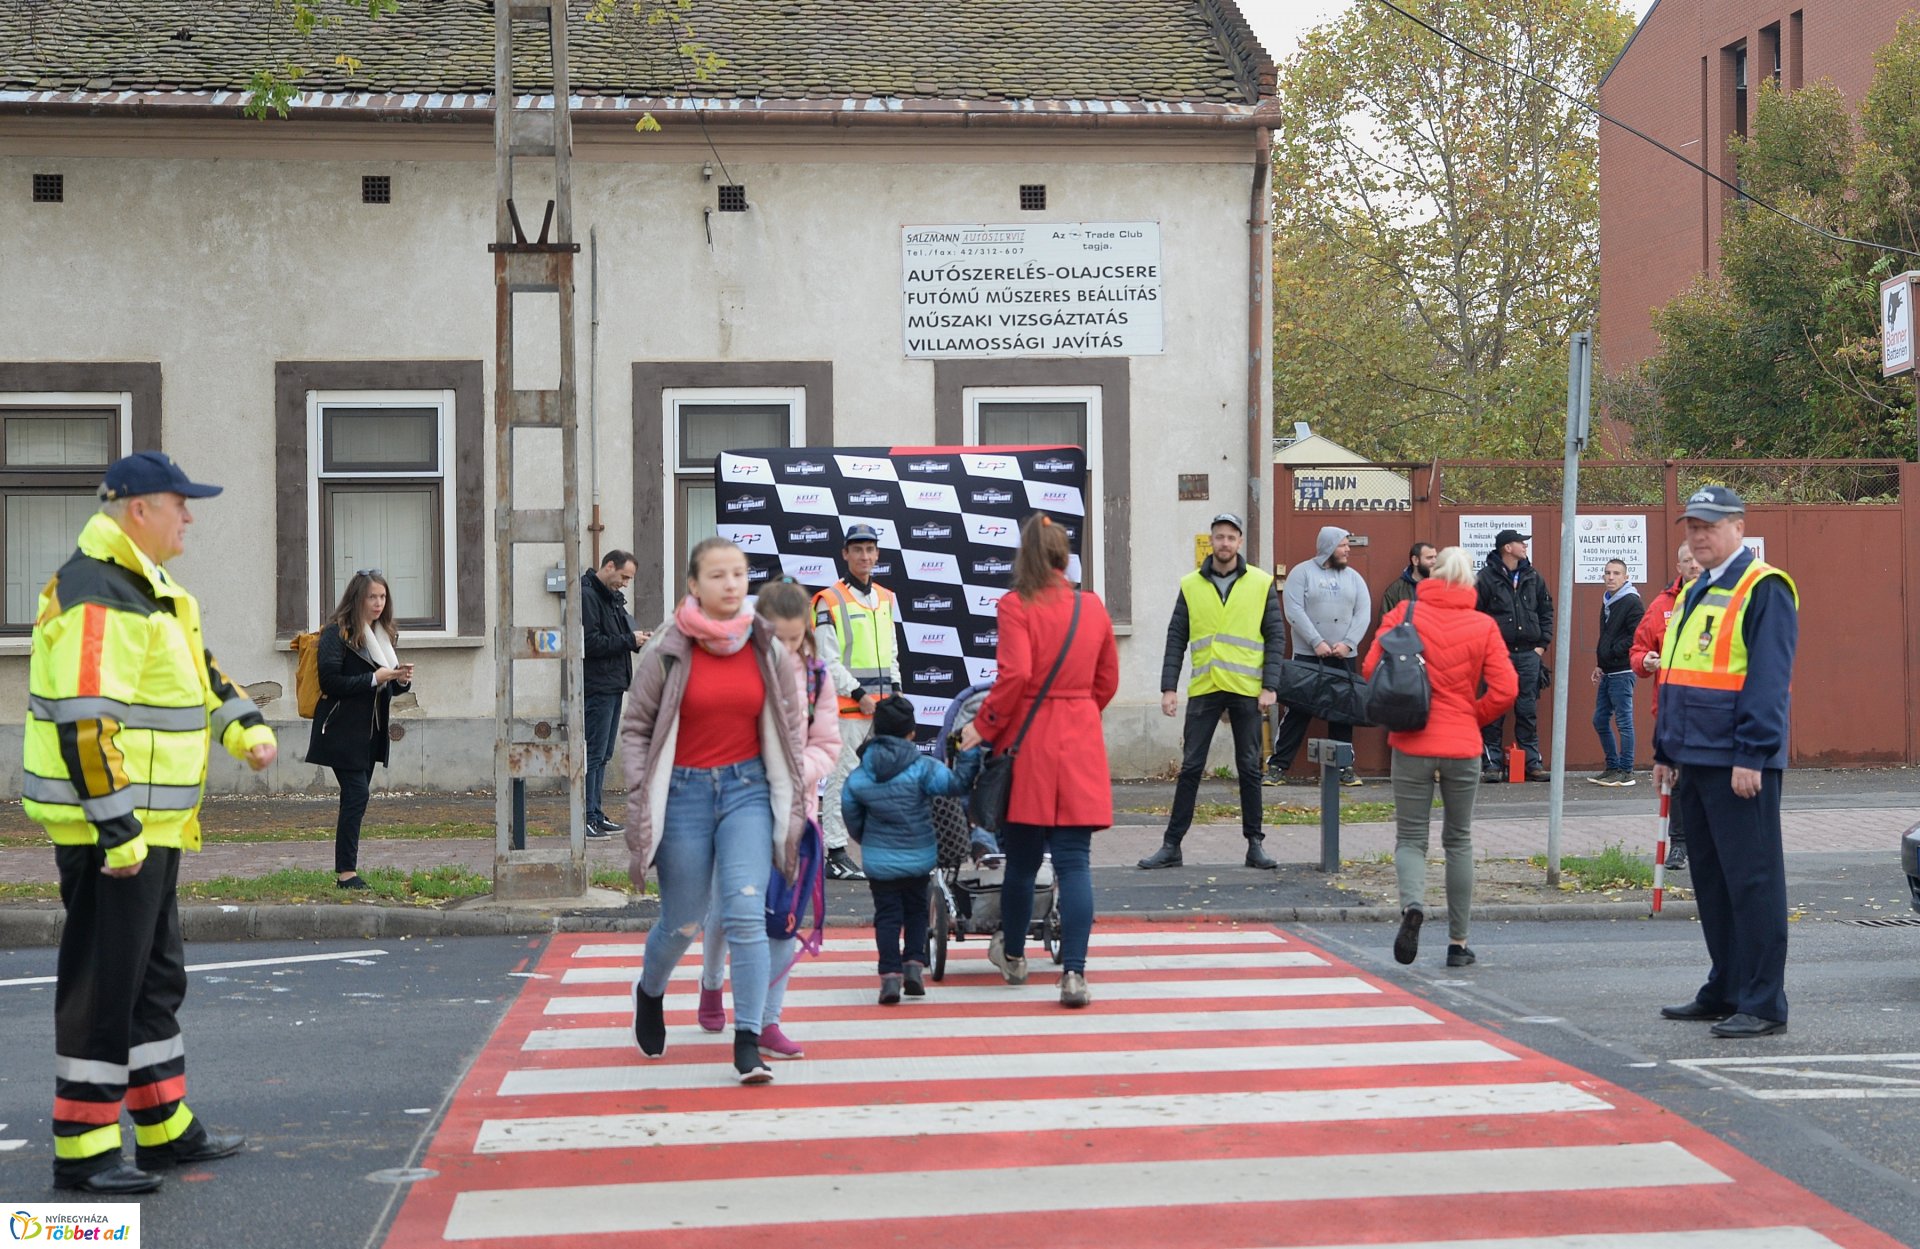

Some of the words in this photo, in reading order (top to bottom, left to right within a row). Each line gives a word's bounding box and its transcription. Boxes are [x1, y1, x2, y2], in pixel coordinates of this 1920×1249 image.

[906, 233, 960, 243] SALZMANN
[1052, 231, 1065, 239] Az
[1085, 231, 1115, 239] Trade
[1119, 230, 1143, 238] Club
[960, 247, 1024, 255] 42/312-607
[1083, 243, 1112, 251] tagja.
[907, 264, 1158, 282] AUTÓSZERELÉS-OLAJCSERE
[907, 287, 979, 305] FUTÓMŰ
[986, 286, 1071, 303] MŰSZERES
[1077, 284, 1158, 301] BEÁLLÍTÁS
[907, 311, 992, 328] MŰSZAKI
[999, 309, 1129, 327] VIZSGÁZTATÁS
[907, 333, 1045, 351] VILLAMOSSÁGI
[1052, 331, 1124, 348] JAVÍTÁS
[1886, 329, 1907, 347] Banner
[1304, 487, 1320, 498] 21
[1490, 520, 1527, 529] Ügyfeleink!
[1578, 535, 1605, 544] VALENT
[1607, 533, 1626, 544] AUTÓ
[1628, 535, 1643, 544] KFT.
